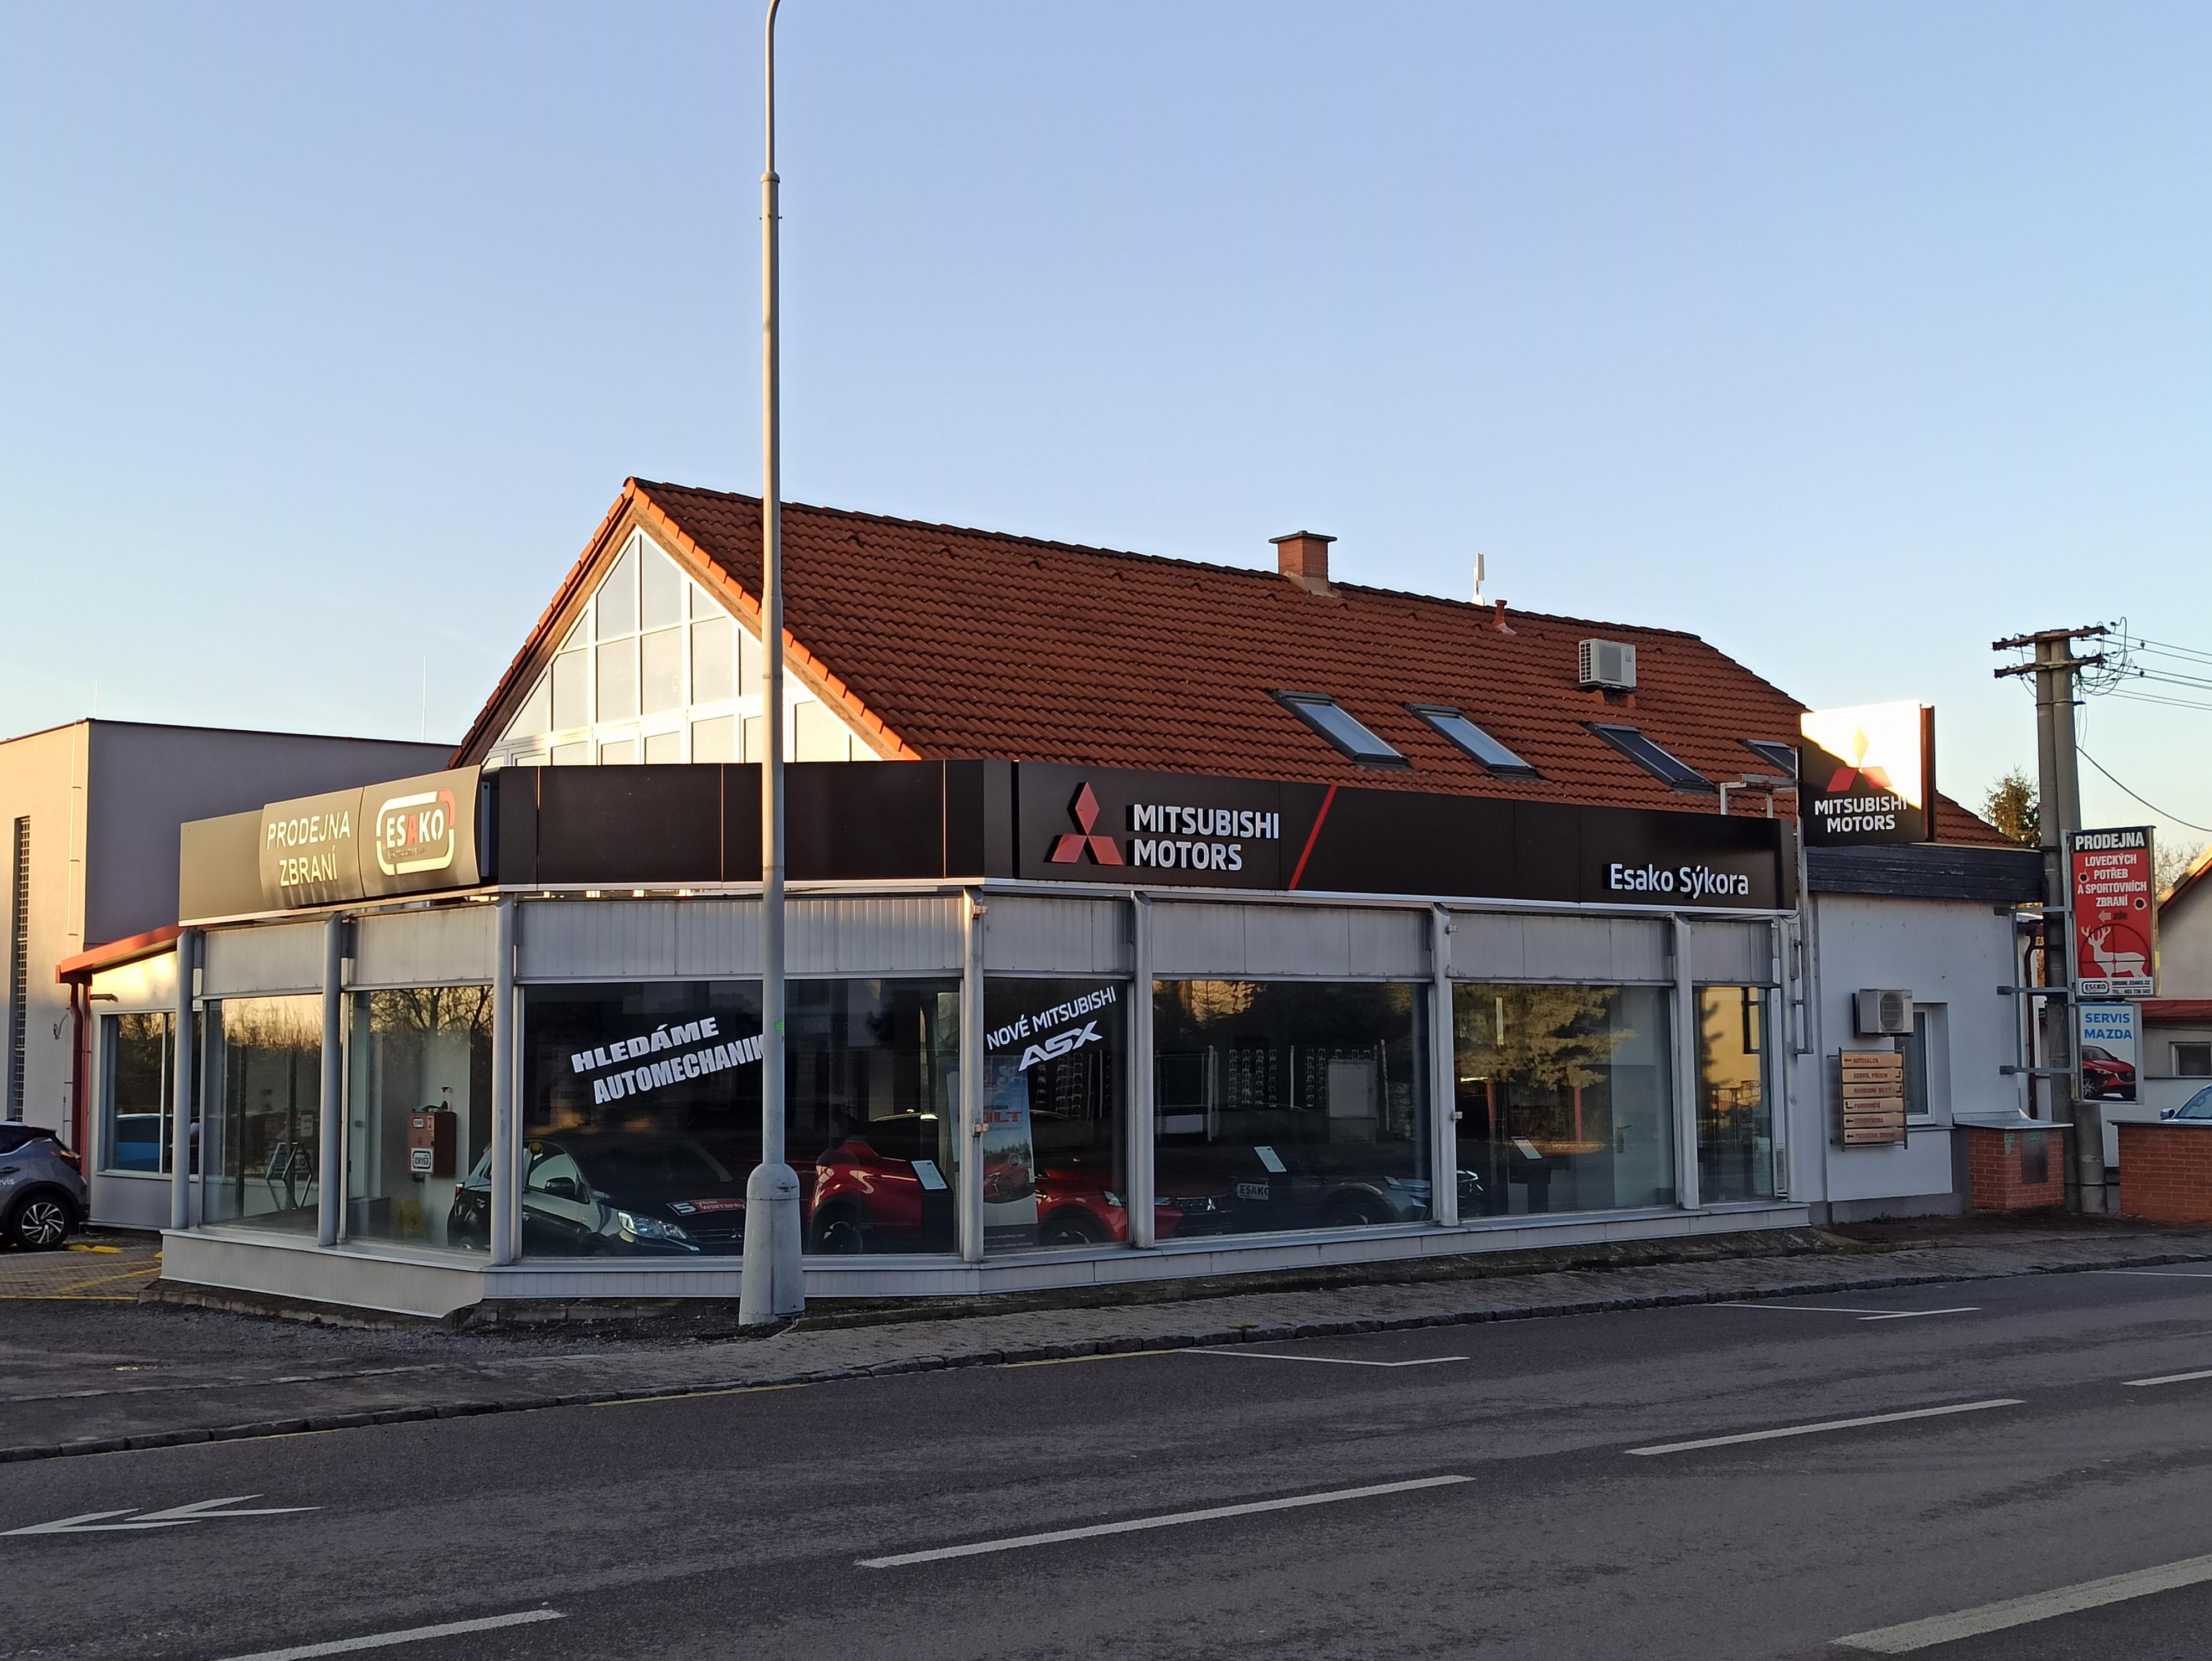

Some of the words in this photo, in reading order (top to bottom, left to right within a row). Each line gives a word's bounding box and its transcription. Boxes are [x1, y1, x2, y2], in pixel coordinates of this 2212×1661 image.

[1814, 796, 1907, 816] MITSUBISHI
[266, 811, 350, 850] PRODEJNA
[386, 809, 444, 848] ESAKO
[1134, 804, 1279, 839] MITSUBISHI
[1827, 814, 1896, 833] MOTORS
[2075, 832, 2145, 850] PRODEJNA
[1135, 839, 1242, 871] MOTORS
[2085, 853, 2137, 867] LOVECKÝCH
[279, 845, 337, 887] ZBRANÍ
[2094, 867, 2128, 880] POTŘEB
[1611, 863, 1673, 892] Esako
[1680, 865, 1749, 900] Sýkora
[2077, 885, 2084, 895] A
[2085, 880, 2147, 895] SPORTOVNÍCH
[2096, 894, 2128, 907] ZBRANÍ
[2113, 911, 2128, 920] zde
[987, 1014, 1030, 1050] NOVÉ
[1032, 986, 1116, 1032] MITSUBISHI
[2085, 1013, 2130, 1023] SERVIS
[2084, 1029, 2133, 1039] MAZDA
[571, 1017, 719, 1073] HLEDÁME
[1019, 1020, 1104, 1072] ASX
[673, 1203, 696, 1213] 5
